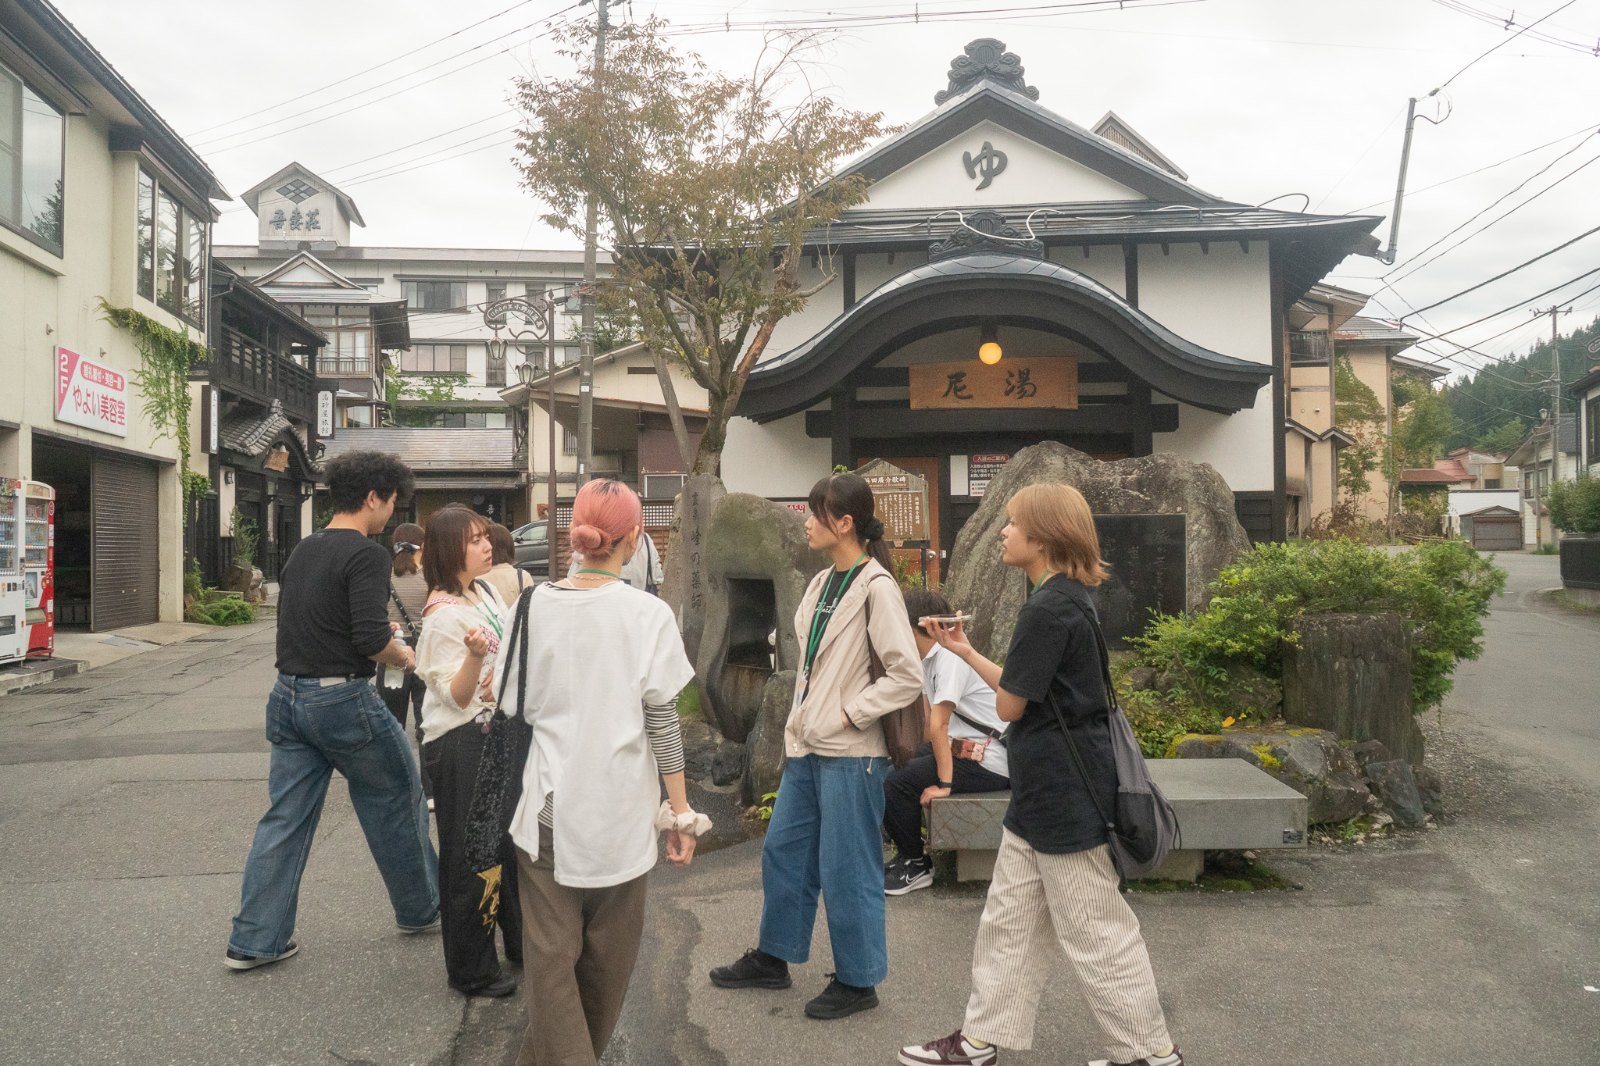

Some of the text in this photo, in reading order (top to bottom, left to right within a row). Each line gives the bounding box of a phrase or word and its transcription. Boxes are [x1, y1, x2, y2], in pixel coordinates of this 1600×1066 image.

[962, 141, 1008, 190] ゆ
[60, 353, 69, 394] 2F
[942, 368, 1038, 401] 尼湯
[72, 384, 126, 426] やよい美容室
